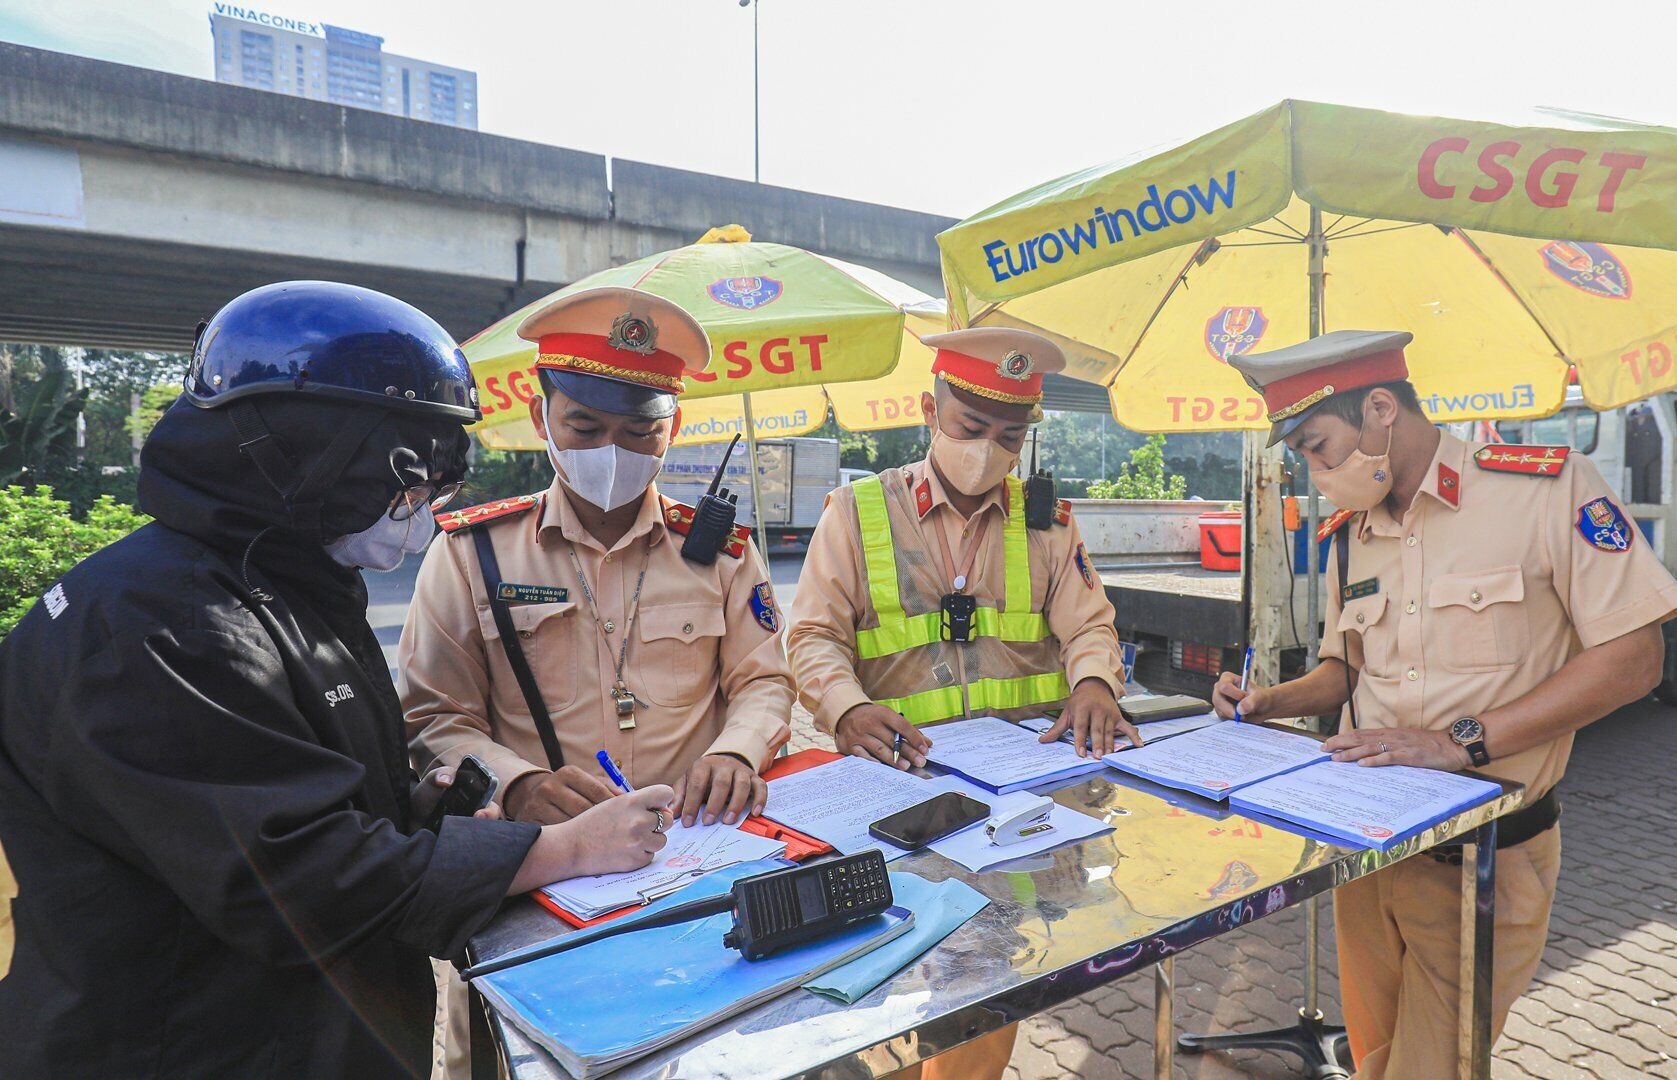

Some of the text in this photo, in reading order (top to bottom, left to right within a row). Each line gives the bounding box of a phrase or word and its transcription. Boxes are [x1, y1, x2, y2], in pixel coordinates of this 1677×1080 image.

[214, 2, 319, 35] VINACONEX
[1417, 137, 1648, 213] CSGT
[982, 169, 1235, 283] Eurowindow
[692, 335, 828, 383] SGT
